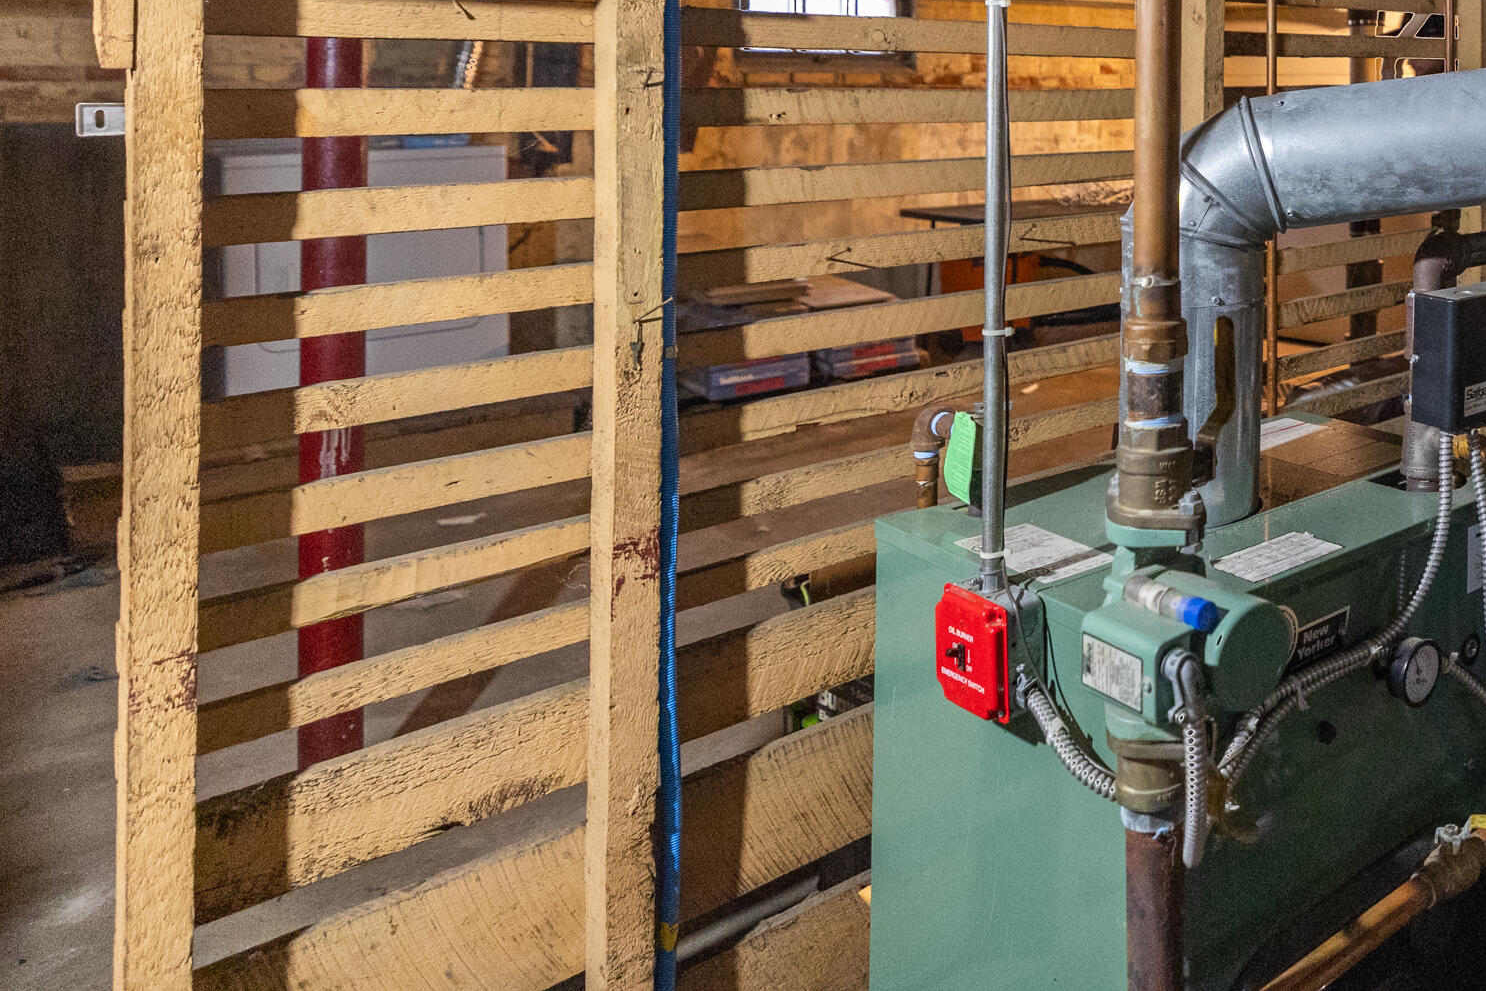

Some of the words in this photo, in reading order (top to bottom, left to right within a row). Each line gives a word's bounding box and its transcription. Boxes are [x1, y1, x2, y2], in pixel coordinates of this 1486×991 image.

[948, 625, 956, 636] OIL
[955, 628, 974, 643] BURNER
[1303, 624, 1329, 645] New
[1298, 635, 1336, 660] Yorker
[941, 666, 968, 685] EMERGENCY
[967, 679, 985, 695] SWITCH
